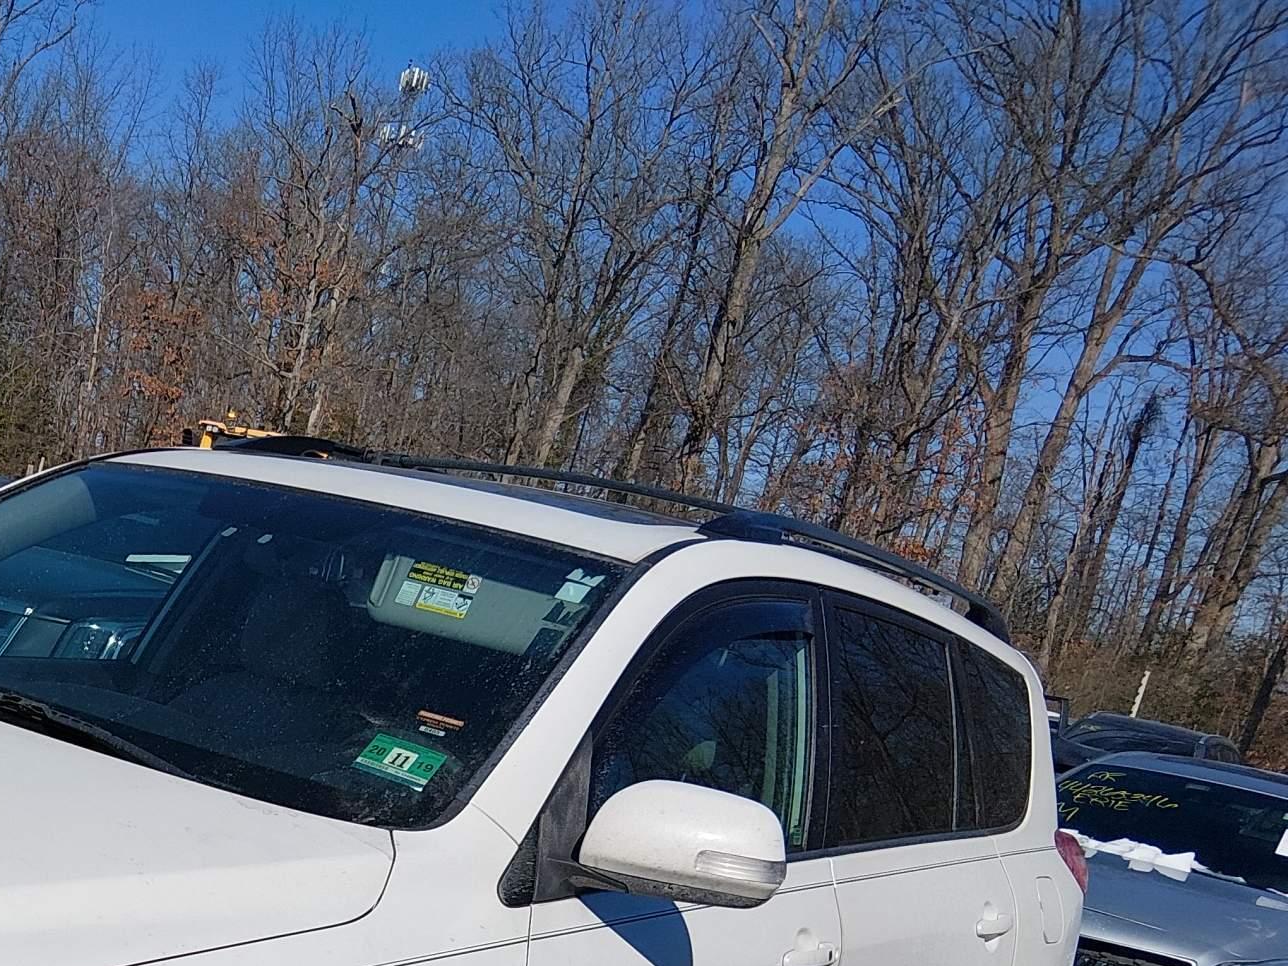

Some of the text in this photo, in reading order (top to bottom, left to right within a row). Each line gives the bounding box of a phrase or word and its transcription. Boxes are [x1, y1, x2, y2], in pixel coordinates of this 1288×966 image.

[368, 745, 387, 757] 20
[388, 752, 410, 769] 11
[416, 761, 434, 773] 19
